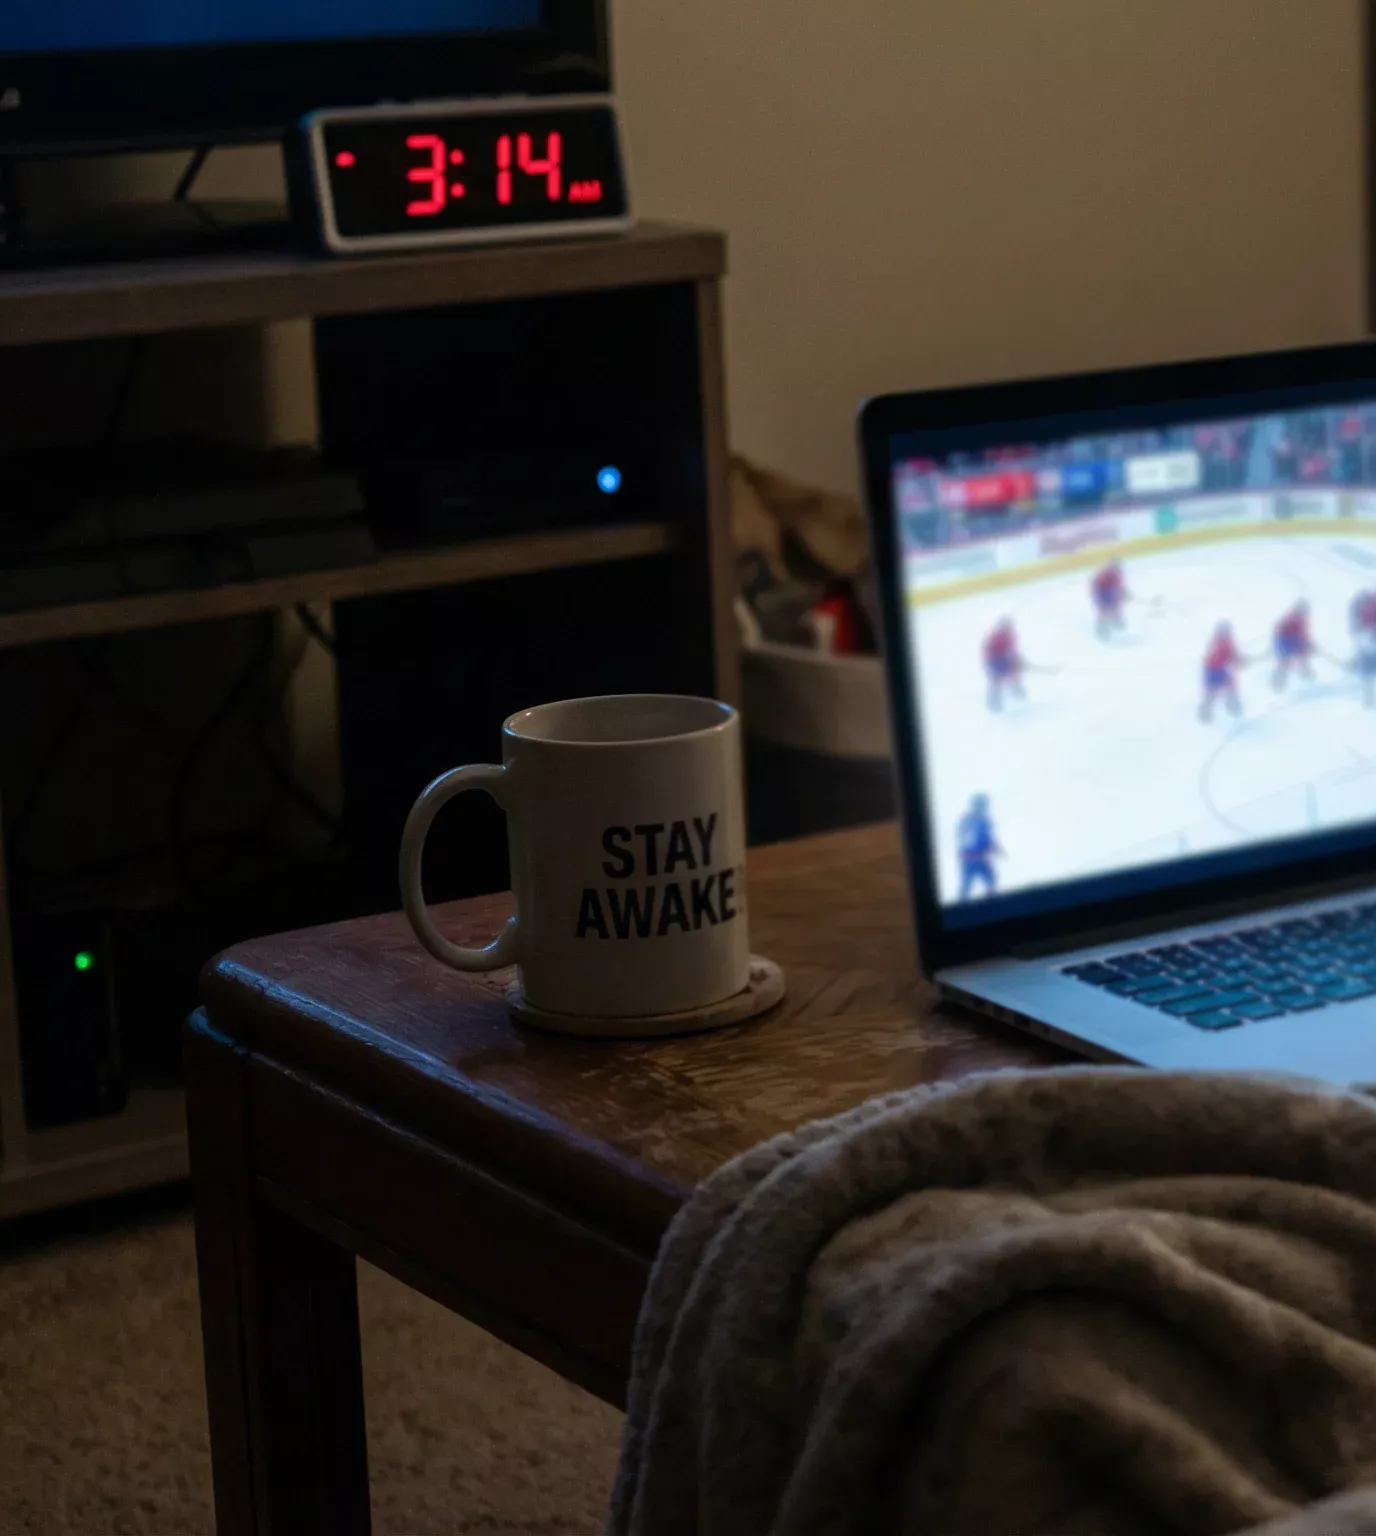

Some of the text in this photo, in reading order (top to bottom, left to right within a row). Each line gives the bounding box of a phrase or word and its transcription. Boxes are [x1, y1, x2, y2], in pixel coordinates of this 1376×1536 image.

[405, 131, 602, 216] 3:14 AM
[601, 812, 718, 879] STAY
[575, 868, 736, 940] AWAKE
